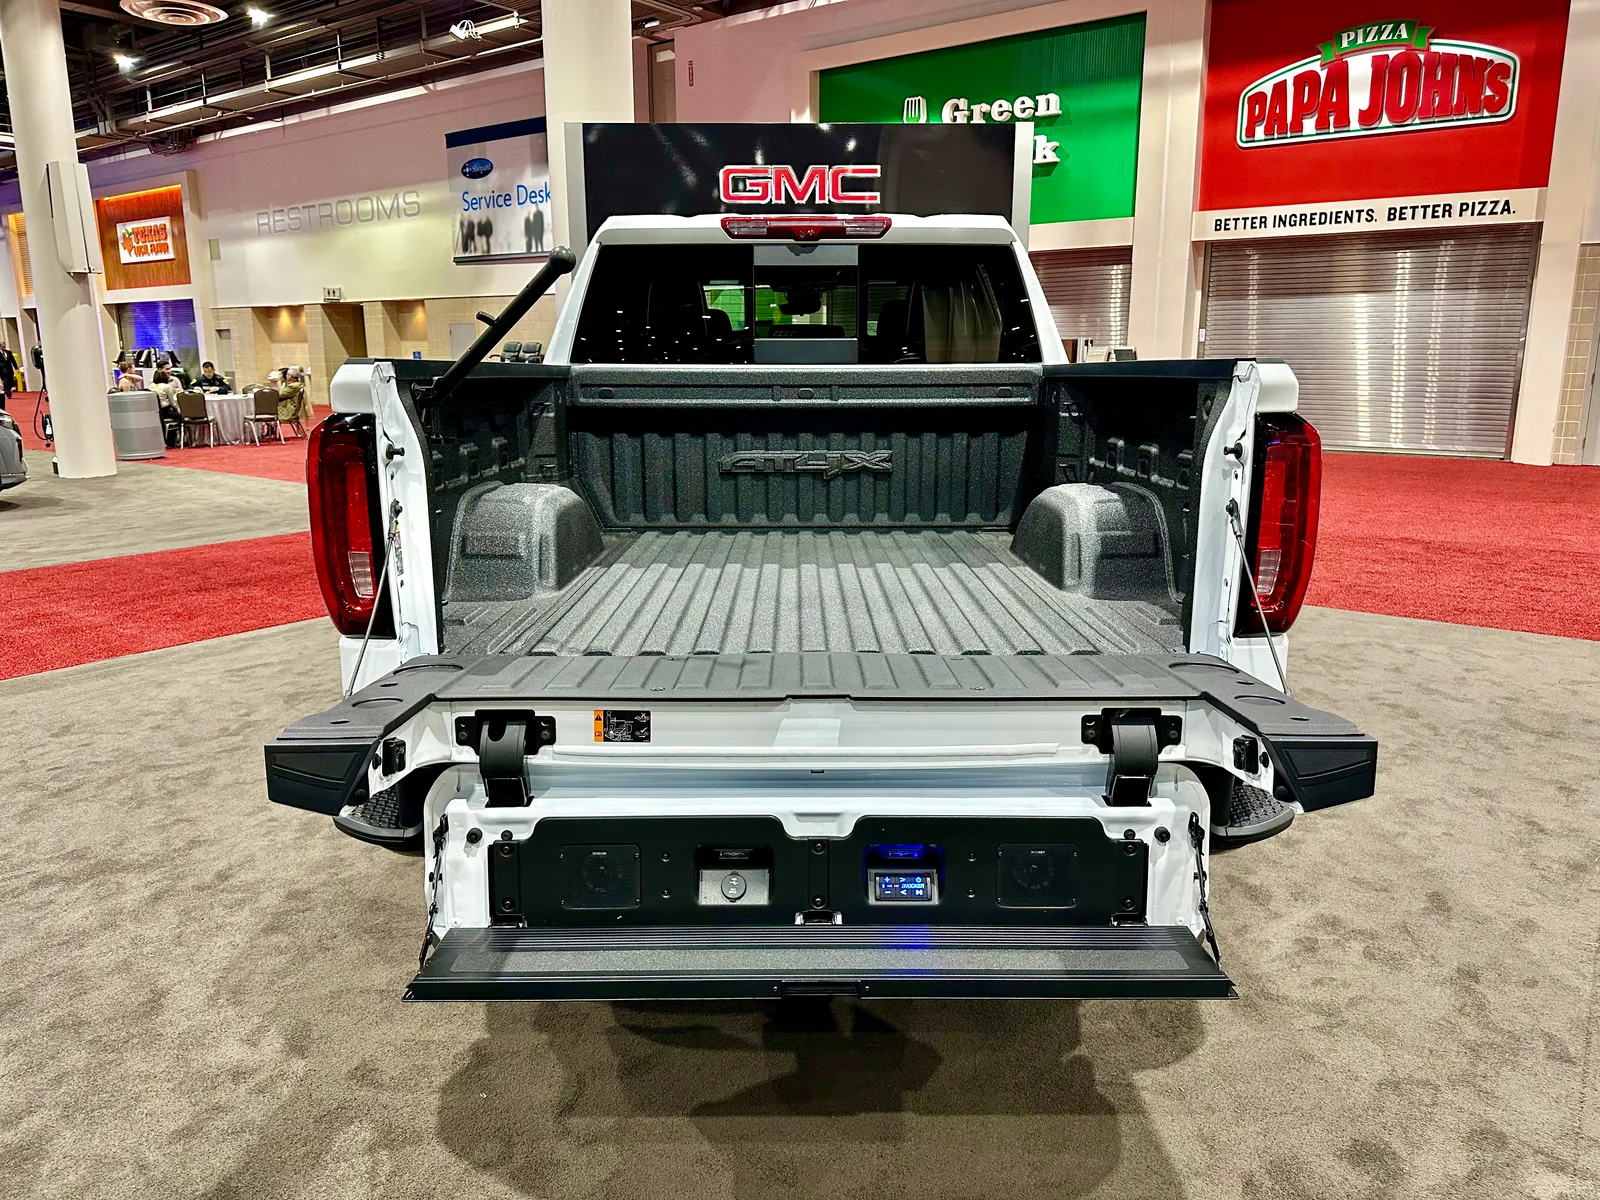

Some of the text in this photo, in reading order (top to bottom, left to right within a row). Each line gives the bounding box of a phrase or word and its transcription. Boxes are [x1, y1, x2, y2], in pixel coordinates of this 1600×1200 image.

[1340, 22, 1408, 49] PIZZA
[941, 92, 1062, 124] Green
[1245, 50, 1512, 138] PAPA JOHN'S
[462, 181, 551, 212] Service Desk
[719, 164, 881, 204] GMC
[256, 189, 421, 236] RESTROOMS
[1214, 199, 1516, 231] BETTER INGREDIENTS. BETTER PIZZA.
[131, 223, 168, 244] TEXAS
[719, 450, 893, 479] AT4X
